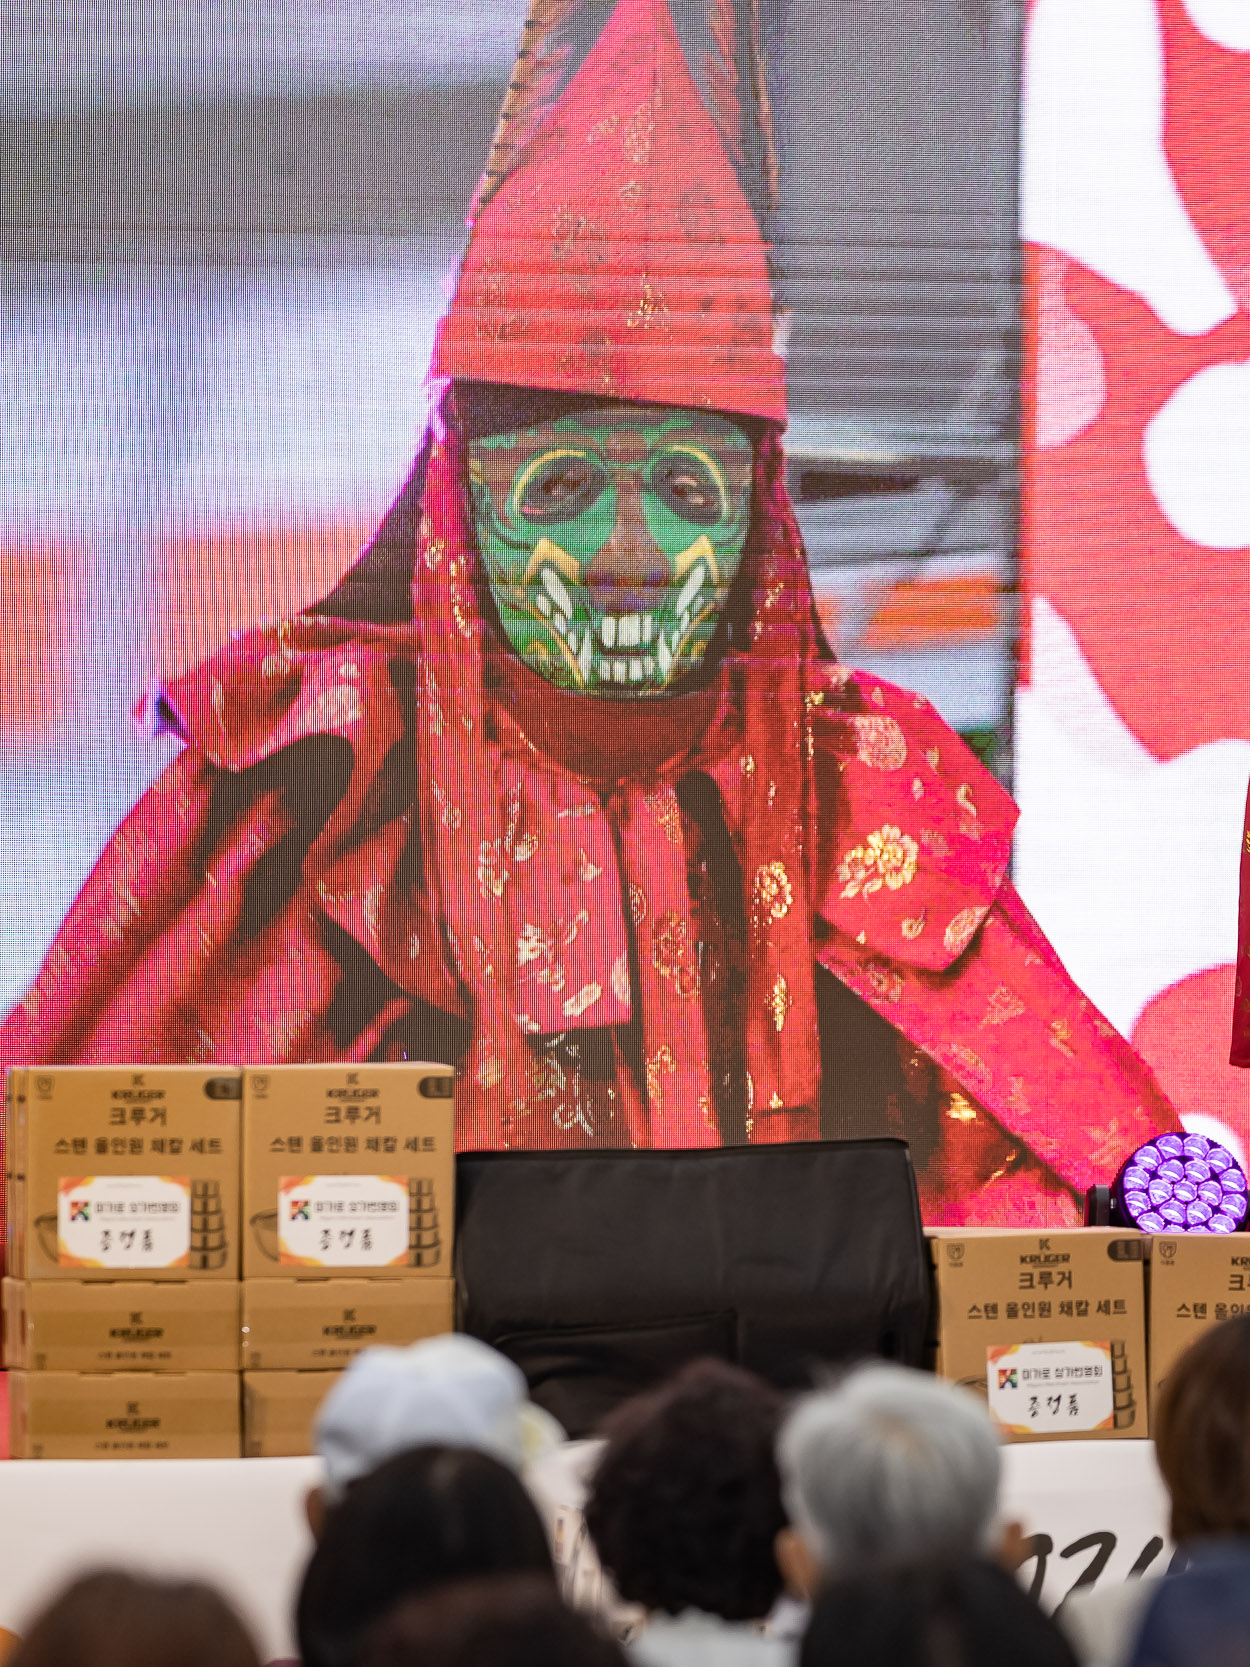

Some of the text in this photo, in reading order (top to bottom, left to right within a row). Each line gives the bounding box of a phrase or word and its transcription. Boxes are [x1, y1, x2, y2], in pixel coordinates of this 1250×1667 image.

[109, 1107, 167, 1126] 크루거
[324, 1106, 381, 1124] 크루거
[190, 1137, 223, 1154] 세트
[404, 1136, 436, 1153] 세트
[1018, 1270, 1073, 1290] 크루거
[968, 1302, 998, 1320] 스텐
[1006, 1301, 1052, 1319] 올인원
[1096, 1299, 1127, 1316] 세트
[1176, 1302, 1207, 1320] 스텐
